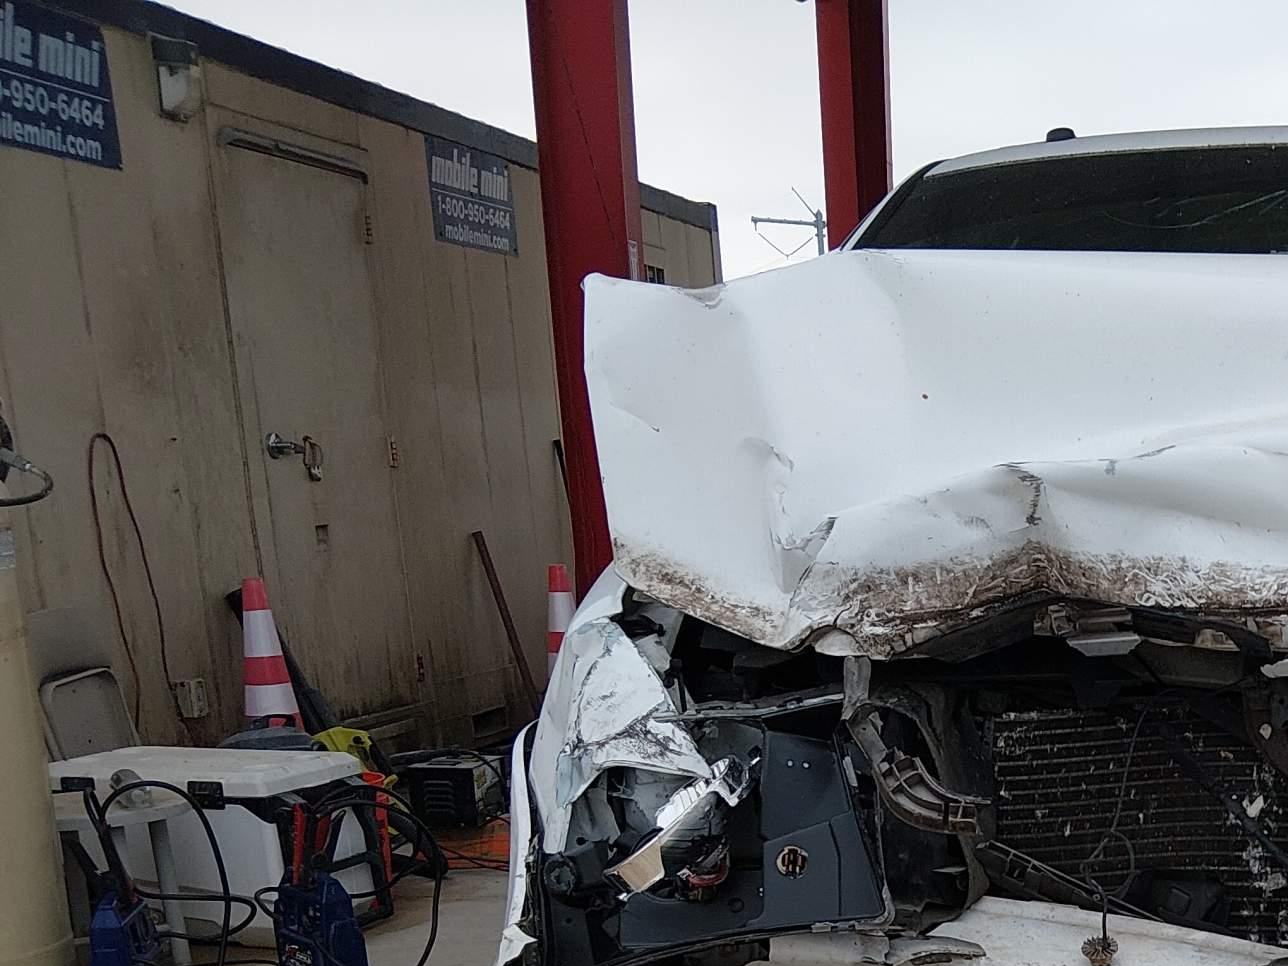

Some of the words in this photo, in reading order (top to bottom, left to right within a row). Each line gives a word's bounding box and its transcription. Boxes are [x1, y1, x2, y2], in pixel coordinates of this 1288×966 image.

[38, 32, 102, 88] mini
[0, 79, 105, 130] -950-6464
[431, 148, 479, 193] mobile
[480, 166, 508, 201] mini
[437, 195, 510, 230] 1-800-950-6464
[445, 223, 510, 251] mobilemini.com
